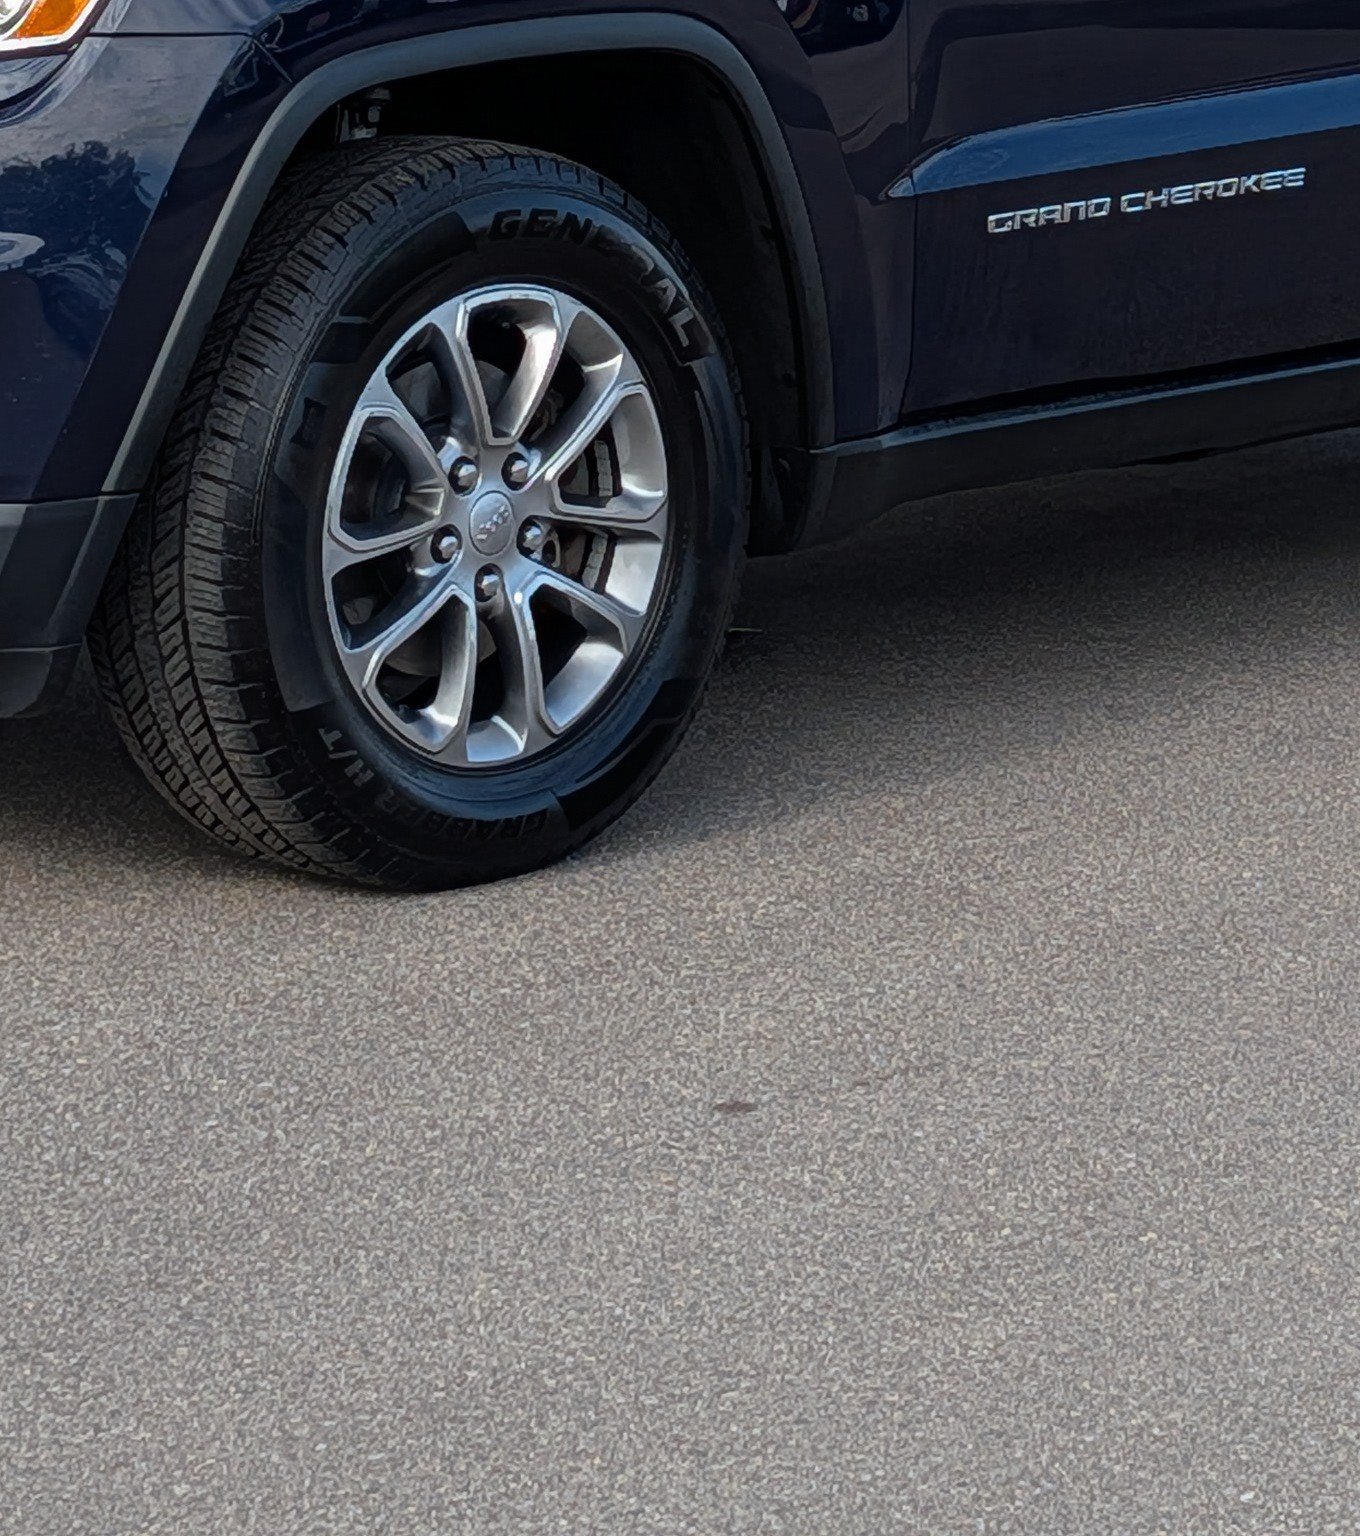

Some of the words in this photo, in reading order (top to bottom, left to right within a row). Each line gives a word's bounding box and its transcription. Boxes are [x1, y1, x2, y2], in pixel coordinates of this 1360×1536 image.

[988, 197, 1111, 234] GRAND
[1121, 167, 1307, 213] CHEROKEE
[488, 207, 696, 348] GENAL
